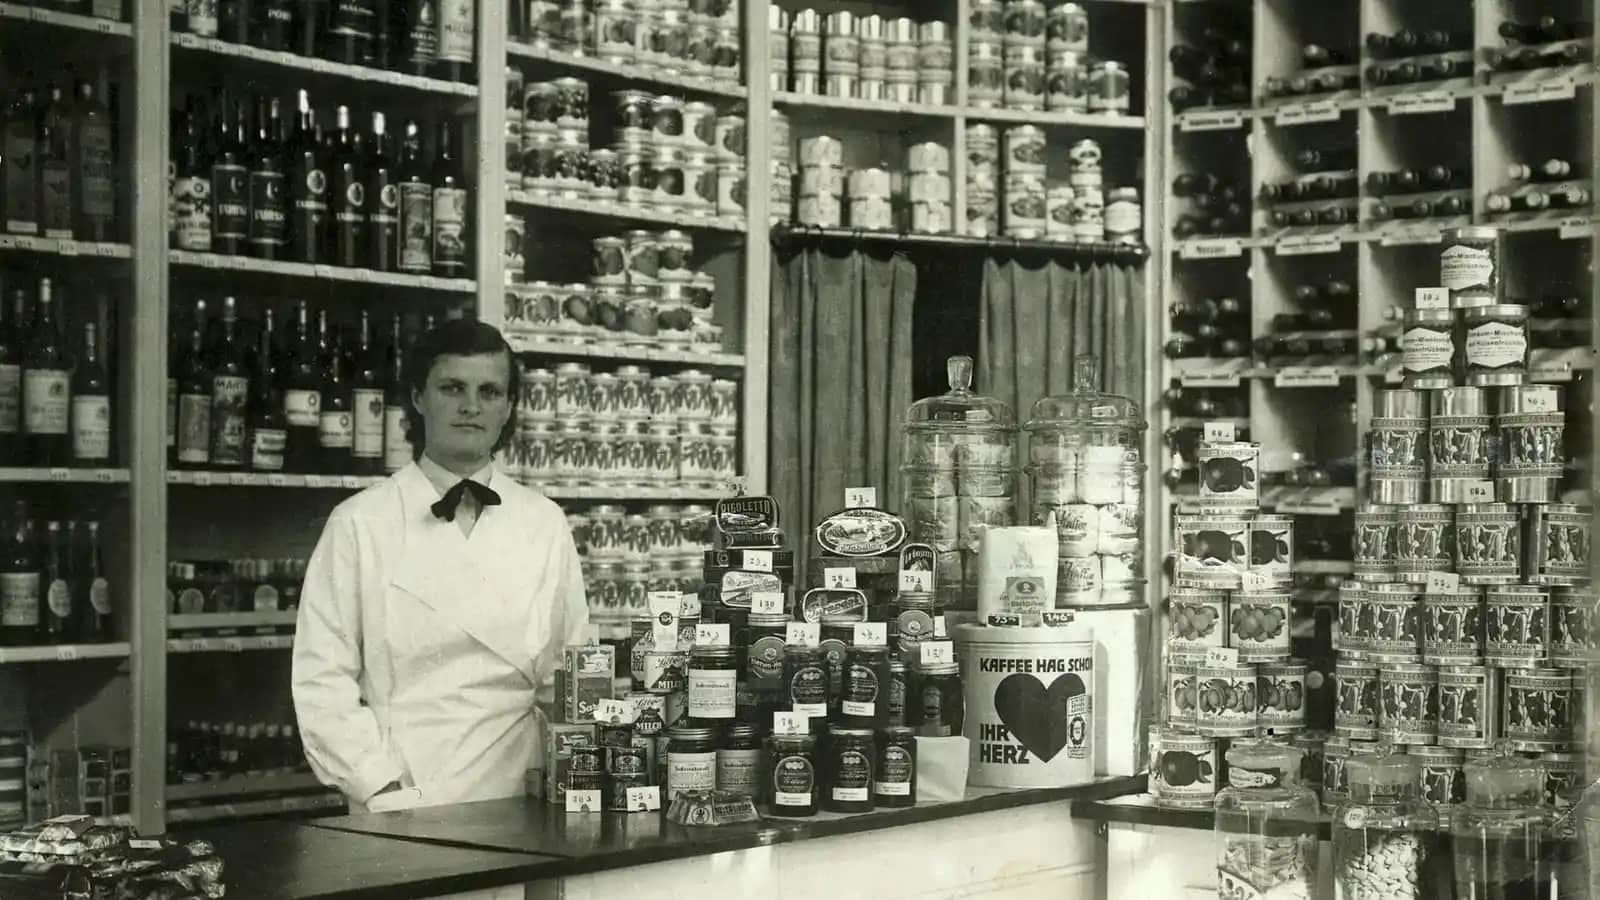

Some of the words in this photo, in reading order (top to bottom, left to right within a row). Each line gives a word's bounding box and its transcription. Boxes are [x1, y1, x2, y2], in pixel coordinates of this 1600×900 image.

[980, 657, 1032, 673] KAFFEE
[1036, 658, 1065, 673] HAG
[1068, 656, 1093, 672] SCHO
[635, 721, 662, 730] MILCH
[979, 723, 1010, 741] IHR
[979, 743, 1030, 765] HERZ
